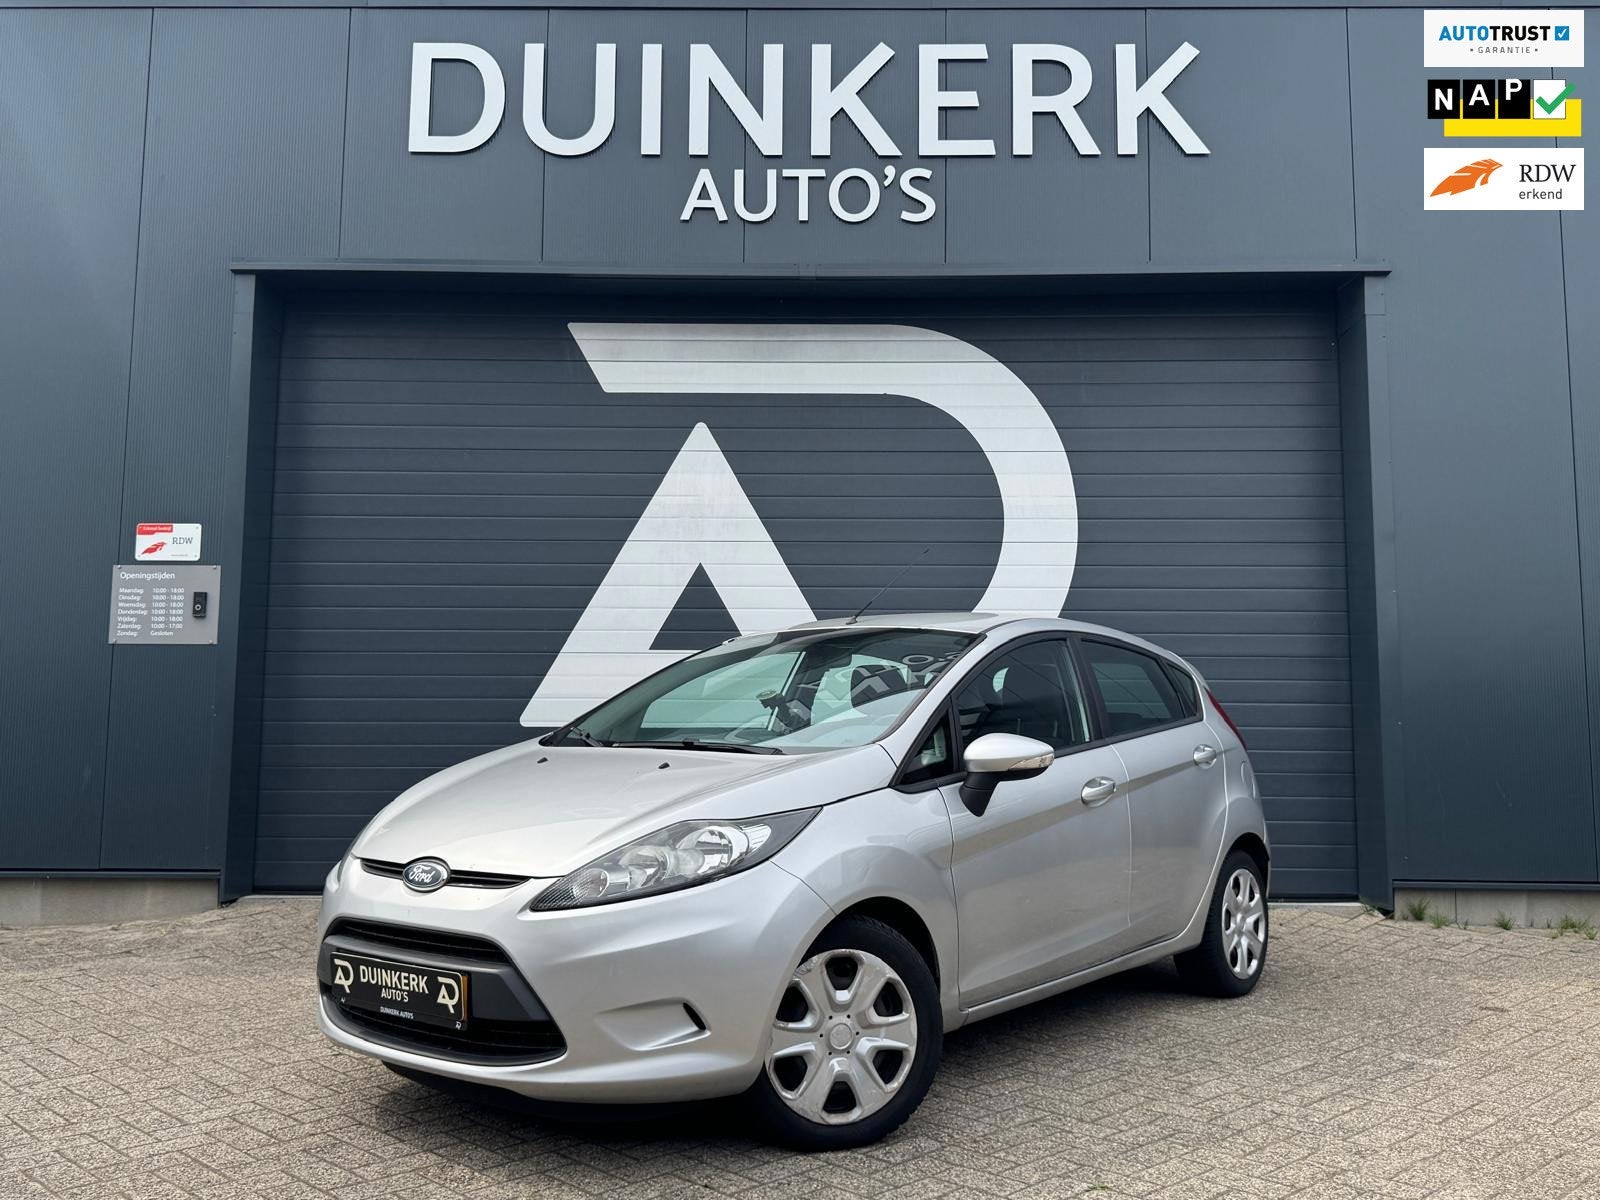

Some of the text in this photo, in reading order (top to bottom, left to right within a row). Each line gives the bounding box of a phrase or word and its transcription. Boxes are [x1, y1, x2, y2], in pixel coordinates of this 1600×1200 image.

[408, 41, 1211, 157] DUINKERK
[679, 165, 937, 223] AUTO’S
[172, 536, 194, 545] RDW
[120, 571, 176, 581] Openingstijden
[408, 865, 436, 883] Ford
[359, 965, 429, 994] DUINKERK
[381, 987, 409, 1002] AUTO'S
[380, 1006, 400, 1016] DUINKERK
